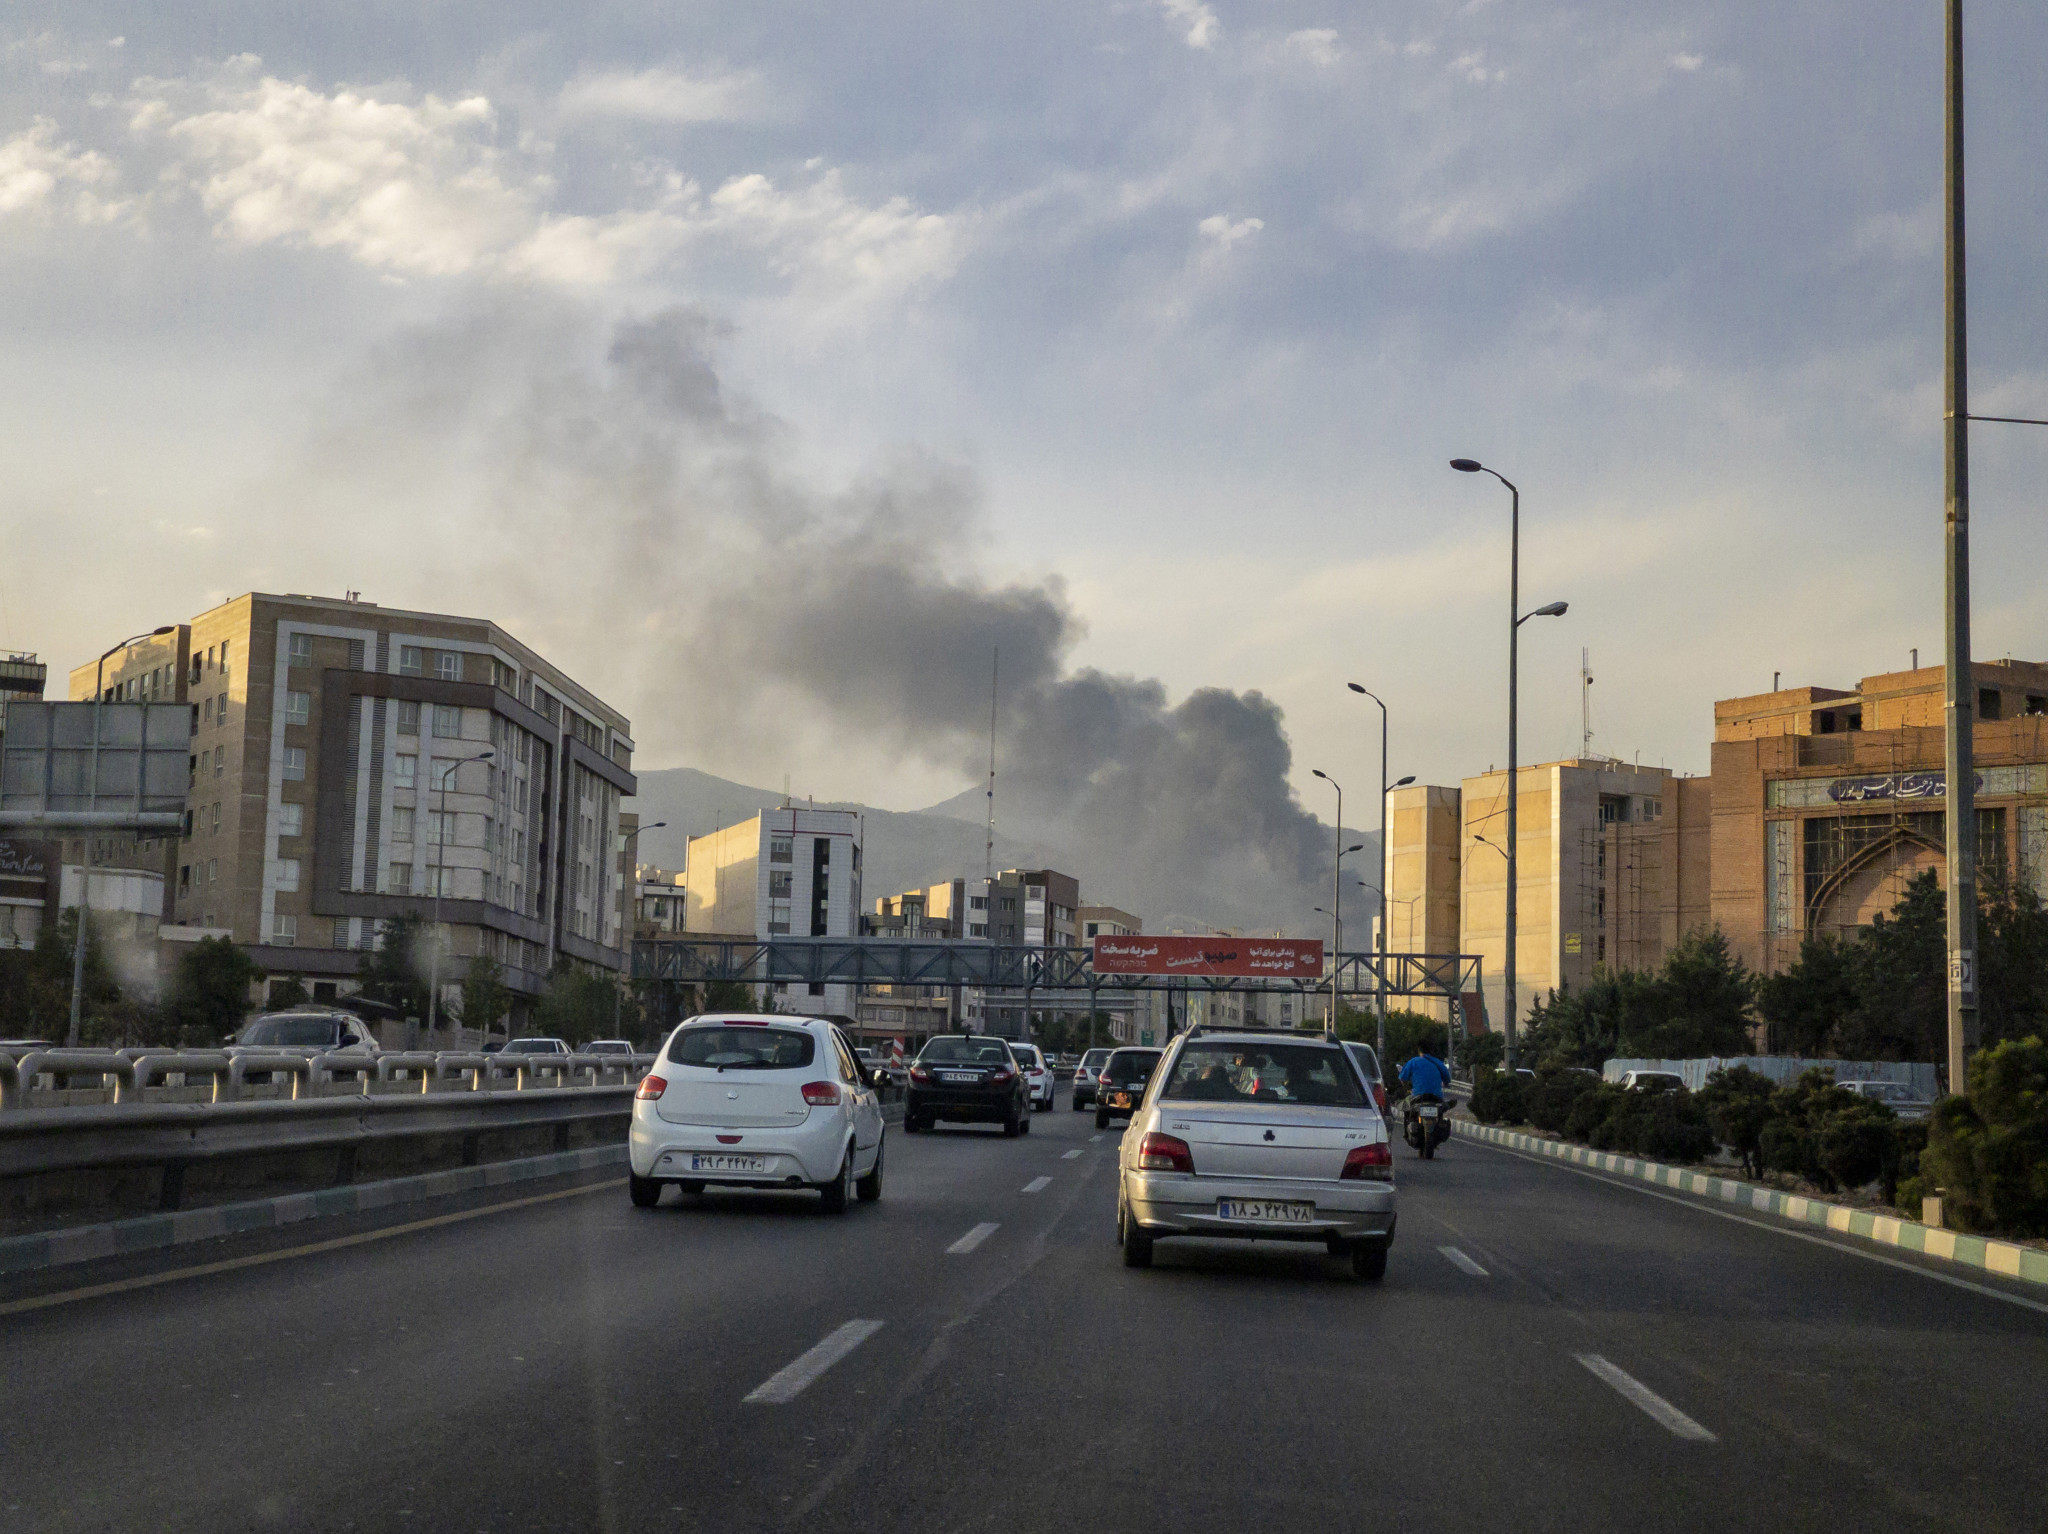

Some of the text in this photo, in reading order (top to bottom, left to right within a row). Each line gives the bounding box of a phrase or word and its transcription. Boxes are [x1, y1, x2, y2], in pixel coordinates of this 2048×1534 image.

[1855, 777, 1895, 800] مذهبی
[1895, 775, 1933, 798] فرهنگی
[1101, 943, 1158, 958] ضربه سخت
[1262, 947, 1276, 958] برای
[1276, 947, 1295, 958] زندگی
[1249, 959, 1261, 968] شد
[1261, 960, 1284, 970] خواهد
